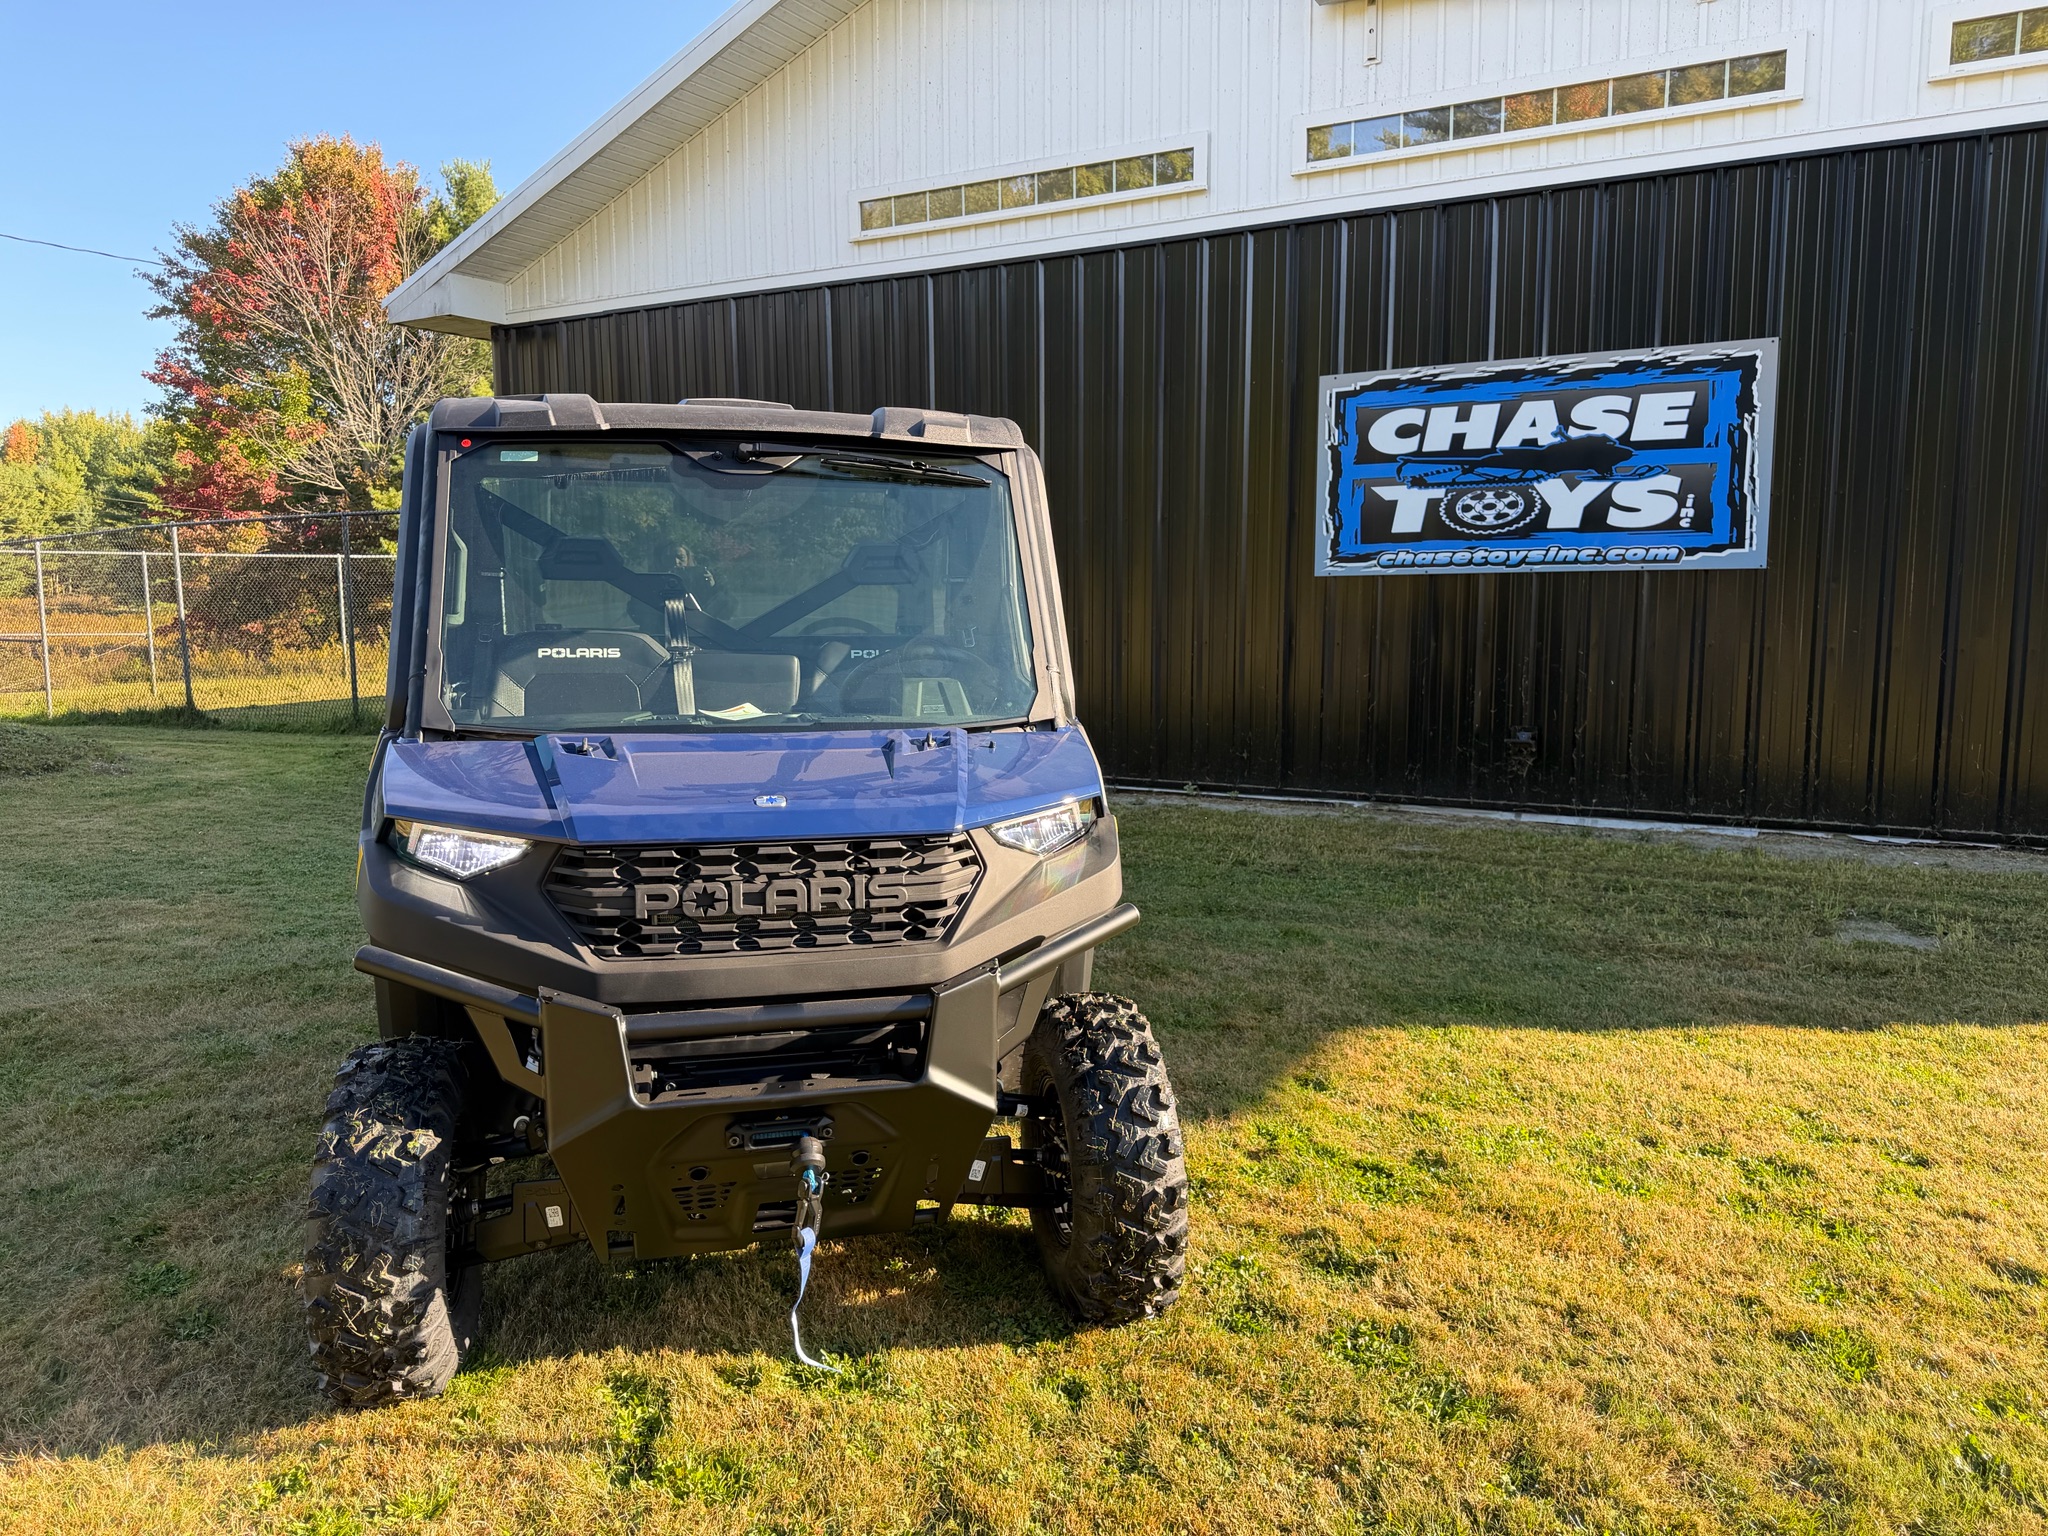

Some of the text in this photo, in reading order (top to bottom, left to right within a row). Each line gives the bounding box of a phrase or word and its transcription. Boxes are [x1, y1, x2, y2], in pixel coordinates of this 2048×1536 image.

[1368, 390, 1696, 455] CHASE
[1378, 545, 1682, 568] chasetoysinc.com
[537, 647, 621, 659] POLARIS
[634, 873, 909, 919] POLARIS
